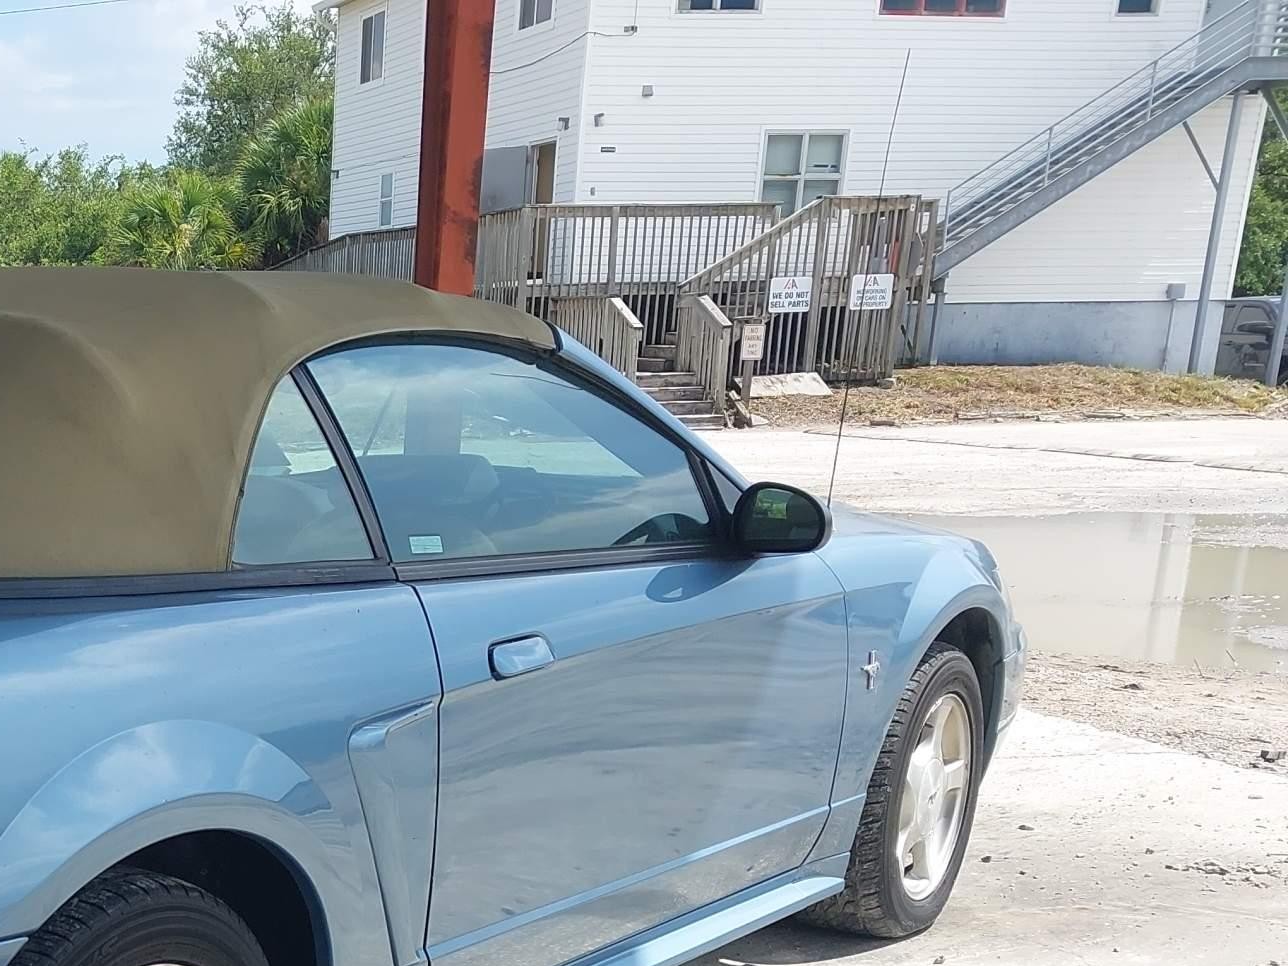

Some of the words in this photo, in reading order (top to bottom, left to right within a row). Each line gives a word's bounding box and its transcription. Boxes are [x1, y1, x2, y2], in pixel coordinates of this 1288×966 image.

[772, 291, 783, 300] WE
[784, 291, 794, 300] DO
[795, 290, 810, 299] NOT
[770, 300, 785, 309] SELL
[787, 299, 809, 308] PARTS
